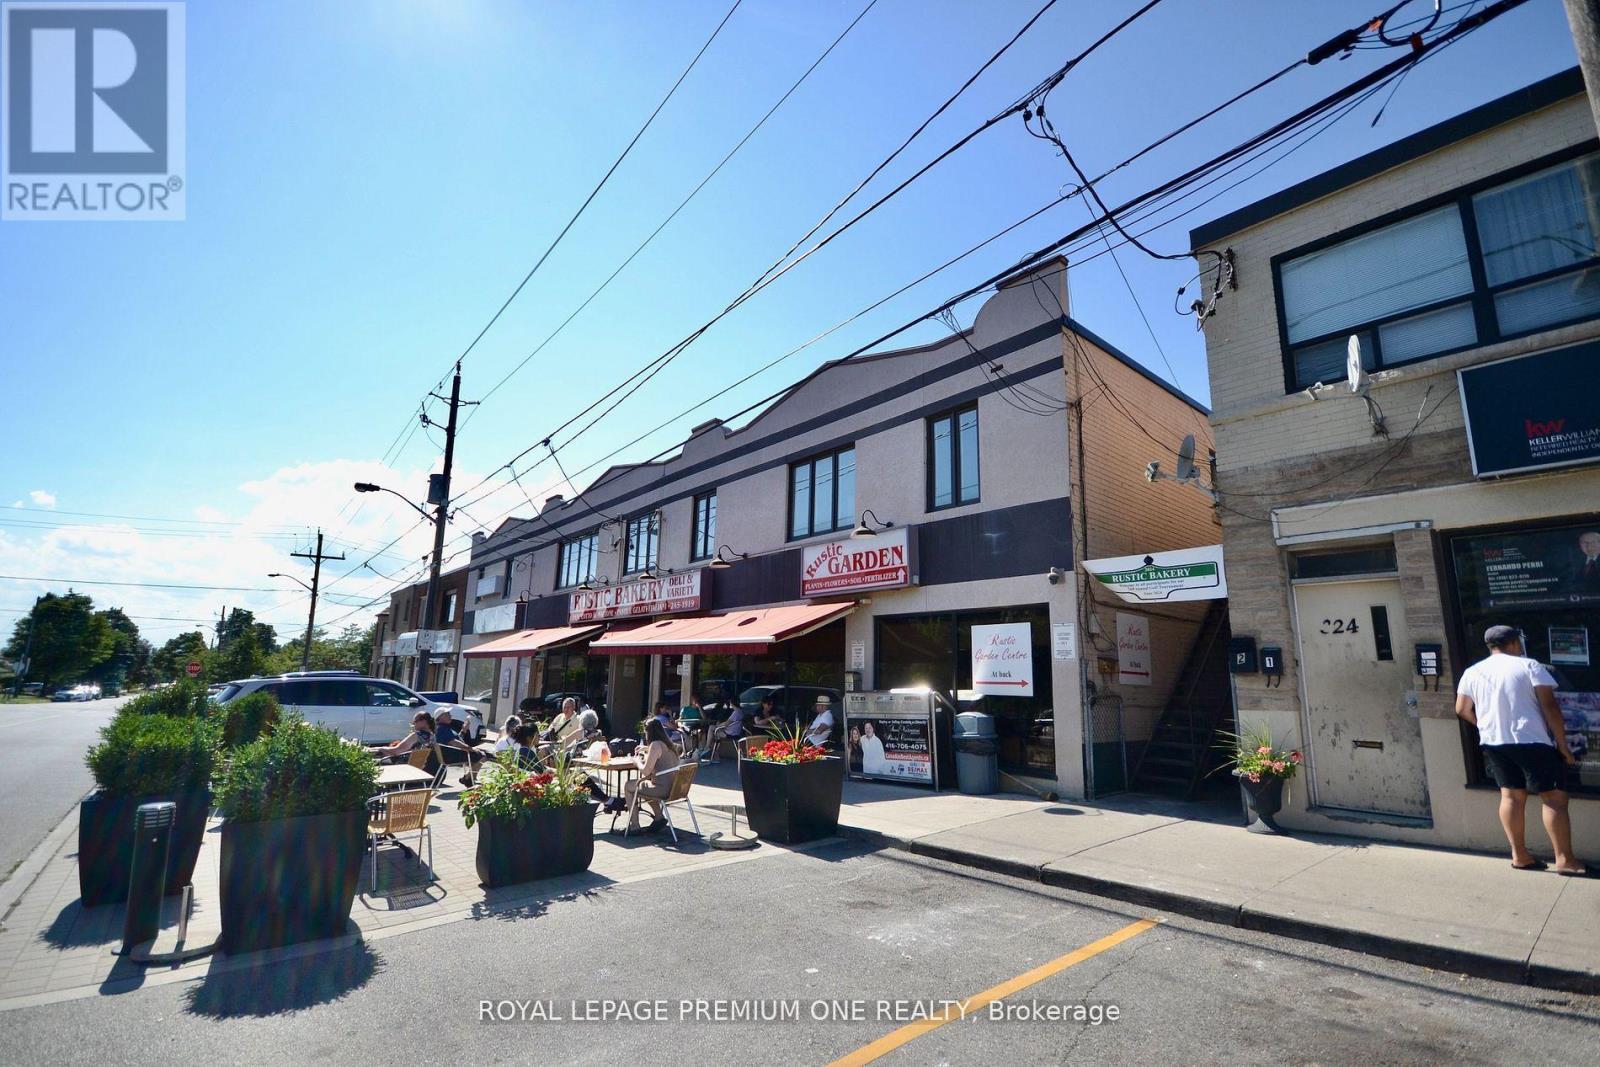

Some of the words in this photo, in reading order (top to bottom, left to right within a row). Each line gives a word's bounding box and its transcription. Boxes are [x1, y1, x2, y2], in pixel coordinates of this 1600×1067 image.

[806, 543, 843, 578] Rustic
[827, 545, 904, 575] GARDEN
[668, 576, 685, 587] DELI
[686, 574, 694, 584] &
[1112, 572, 1148, 583] RUSTIC
[1149, 567, 1191, 580] BAKERY
[574, 588, 612, 609] RUSTIC
[614, 578, 666, 604] BAKERY
[666, 585, 694, 598] VARIETY
[1238, 654, 1245, 664] 2
[885, 743, 927, 751] 416-706-4075
